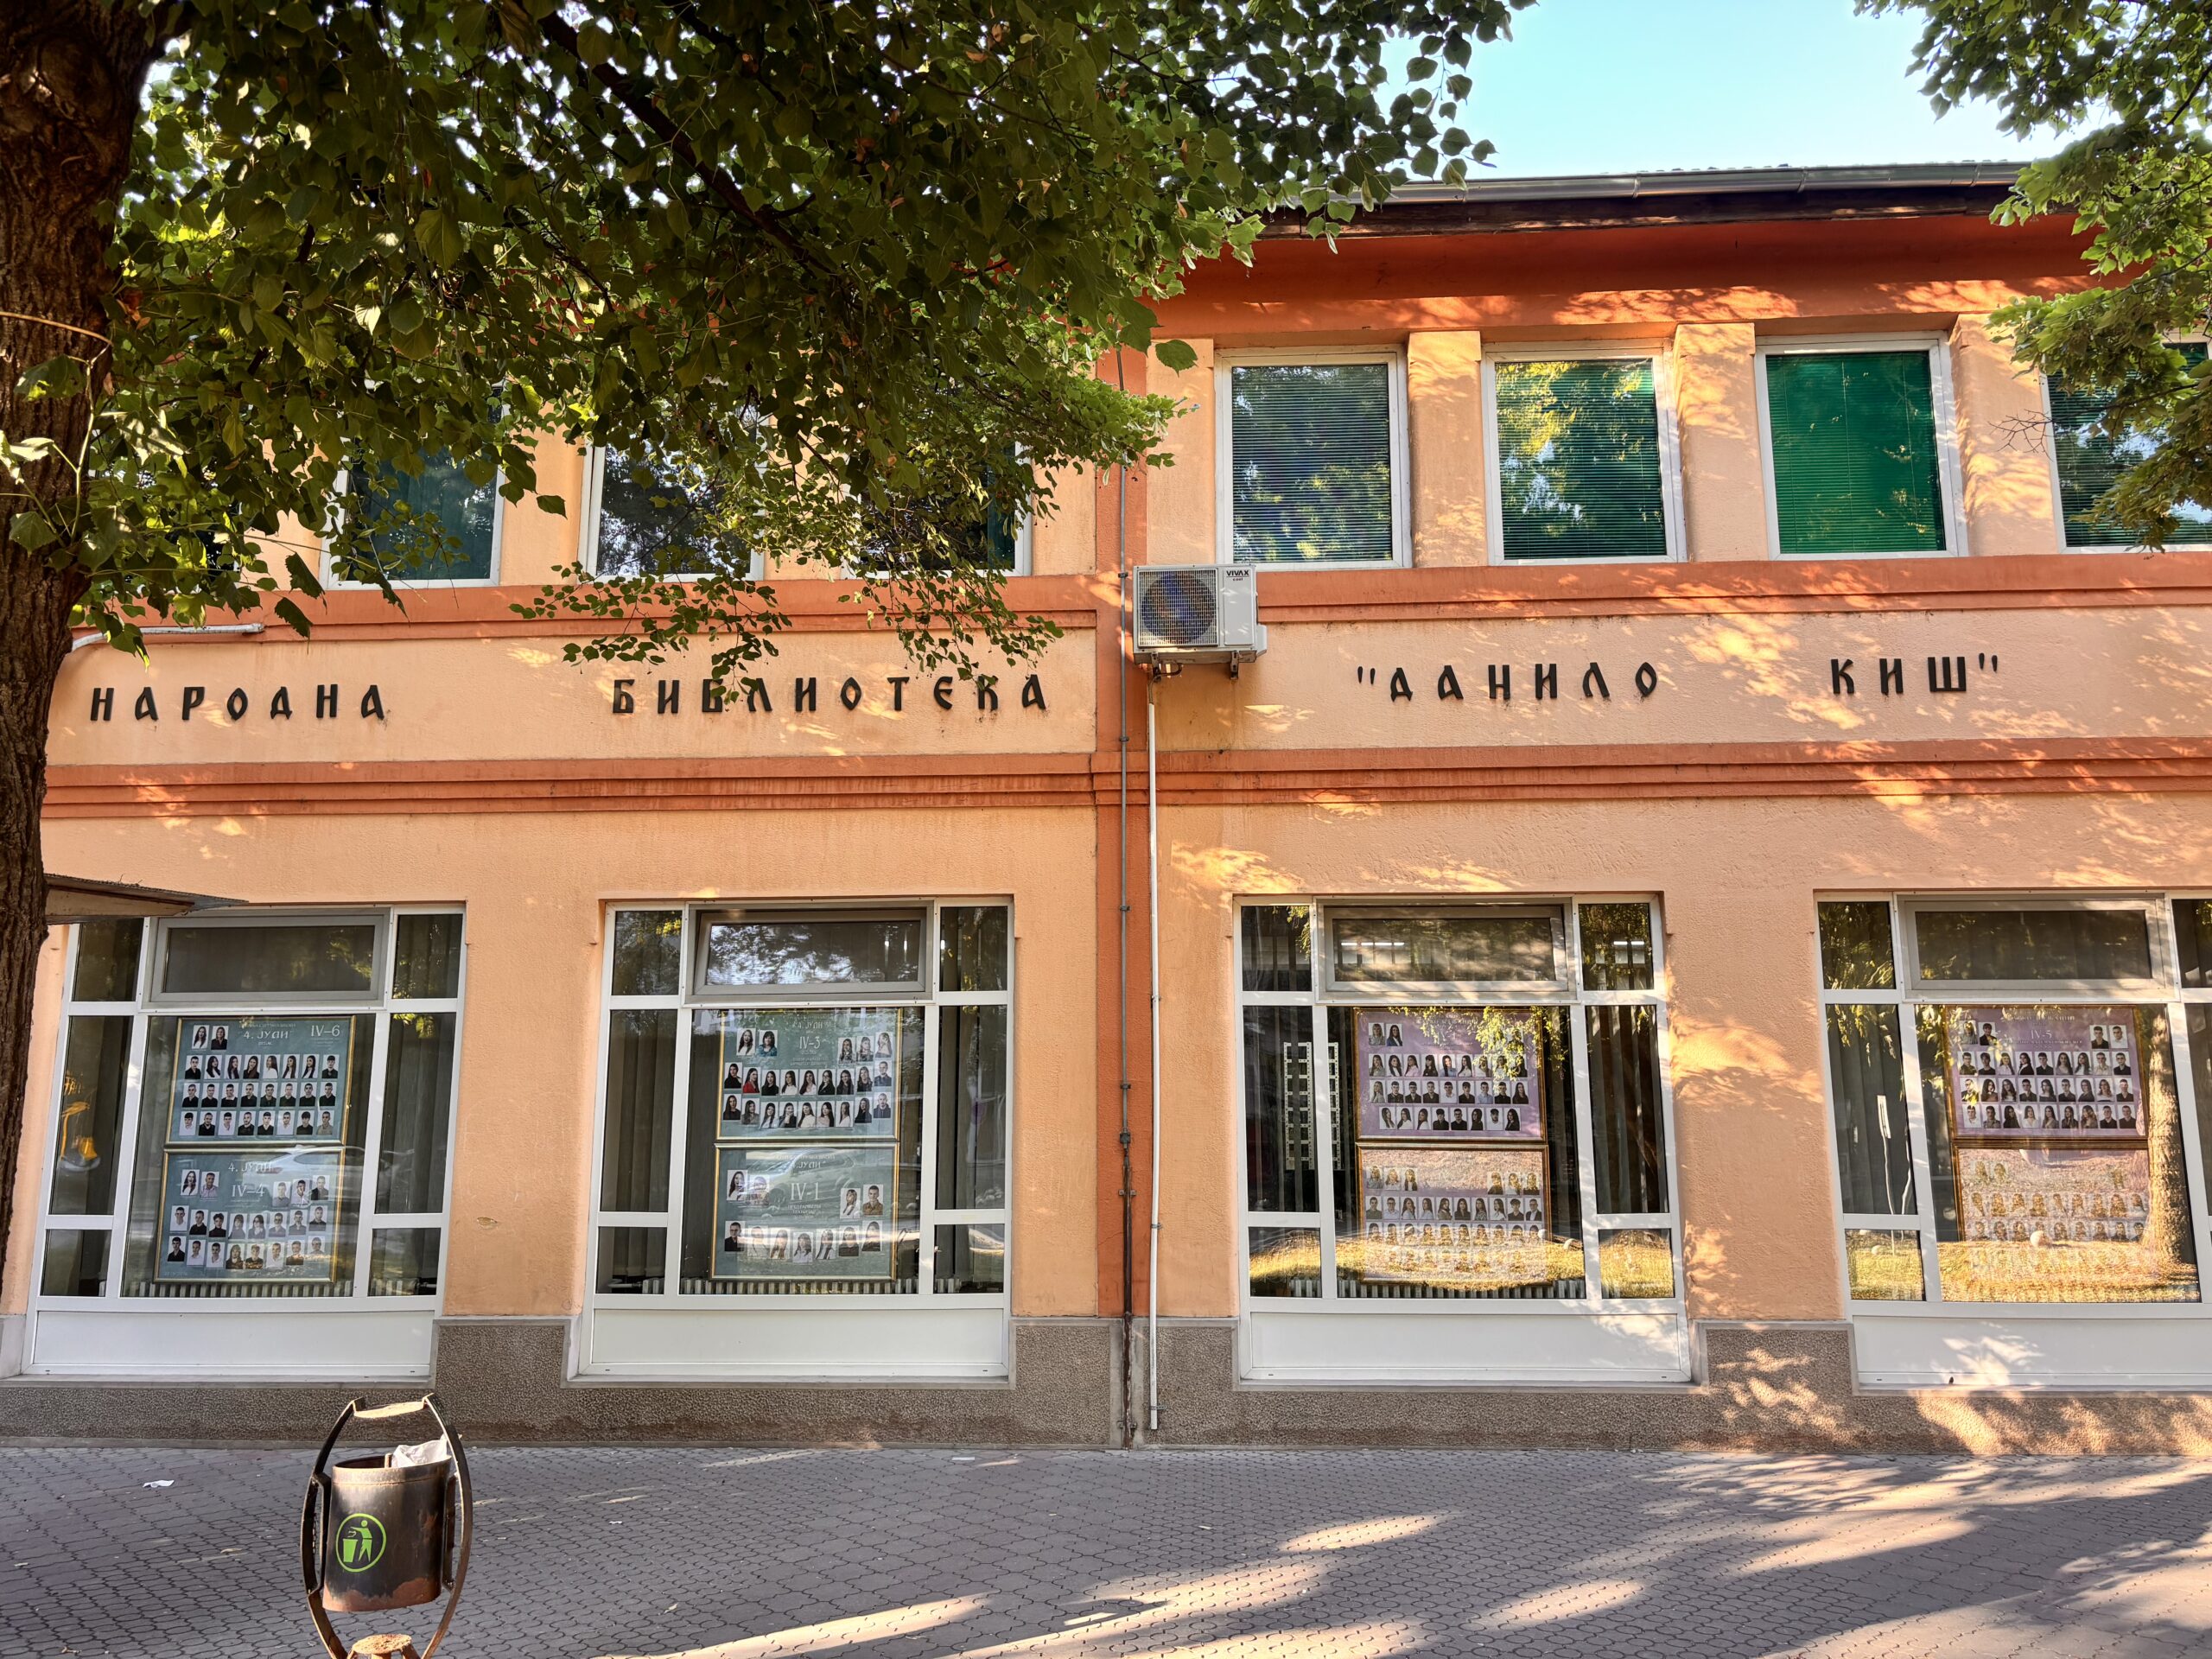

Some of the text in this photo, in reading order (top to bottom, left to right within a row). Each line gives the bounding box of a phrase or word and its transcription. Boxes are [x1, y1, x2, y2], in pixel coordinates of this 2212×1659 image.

[90, 674, 1046, 721] НАРОДНА БИБЛИОТЕКА
[1357, 652, 1998, 702] "ДАНИЛО КИШ"
